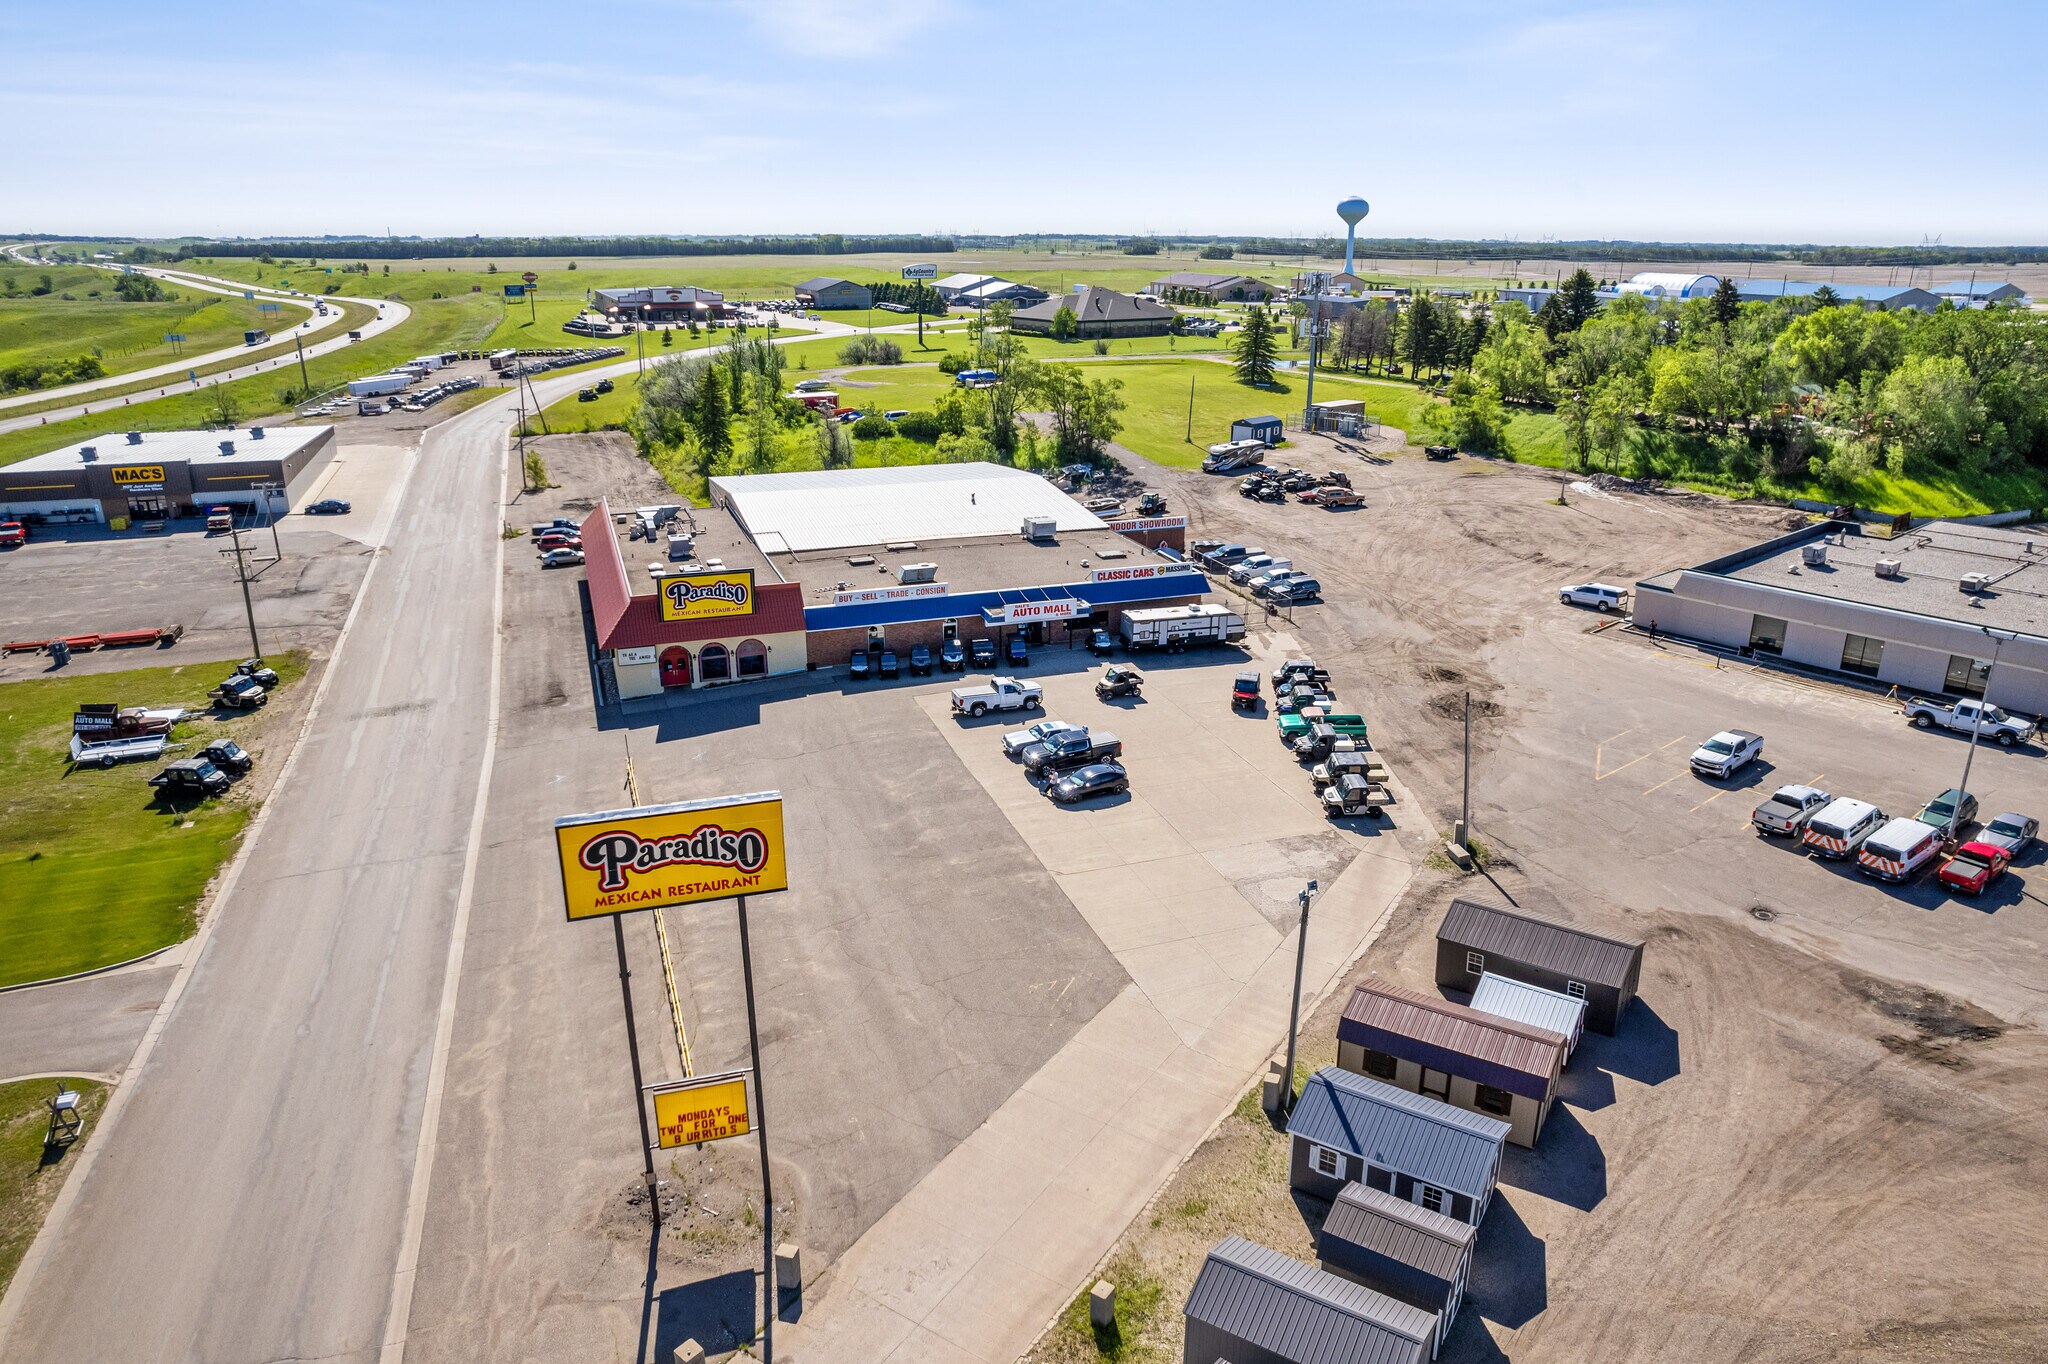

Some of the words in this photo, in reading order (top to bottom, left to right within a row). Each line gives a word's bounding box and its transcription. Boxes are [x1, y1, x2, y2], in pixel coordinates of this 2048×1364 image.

[115, 469, 163, 480] MAC'S
[1138, 517, 1184, 529] SHOWROOM
[1097, 570, 1131, 582] CLASSIC
[1132, 568, 1155, 579] CARS
[1165, 564, 1191, 573] MASSIMO
[838, 594, 853, 603] BUY
[861, 592, 878, 601] SELL
[886, 589, 909, 599] TRADE
[915, 586, 946, 596] CONSIGN
[671, 609, 702, 617] MEXICAN
[703, 606, 745, 615] RESTAURANT
[1012, 607, 1040, 617] AUTO
[1044, 604, 1071, 614] MALL
[594, 887, 662, 908] MEXICAN
[668, 875, 761, 897] RESTAURANT
[678, 1106, 730, 1124] MONDAYS
[660, 1124, 684, 1136] TWO
[694, 1118, 716, 1130] FOR
[728, 1112, 748, 1125] ONE
